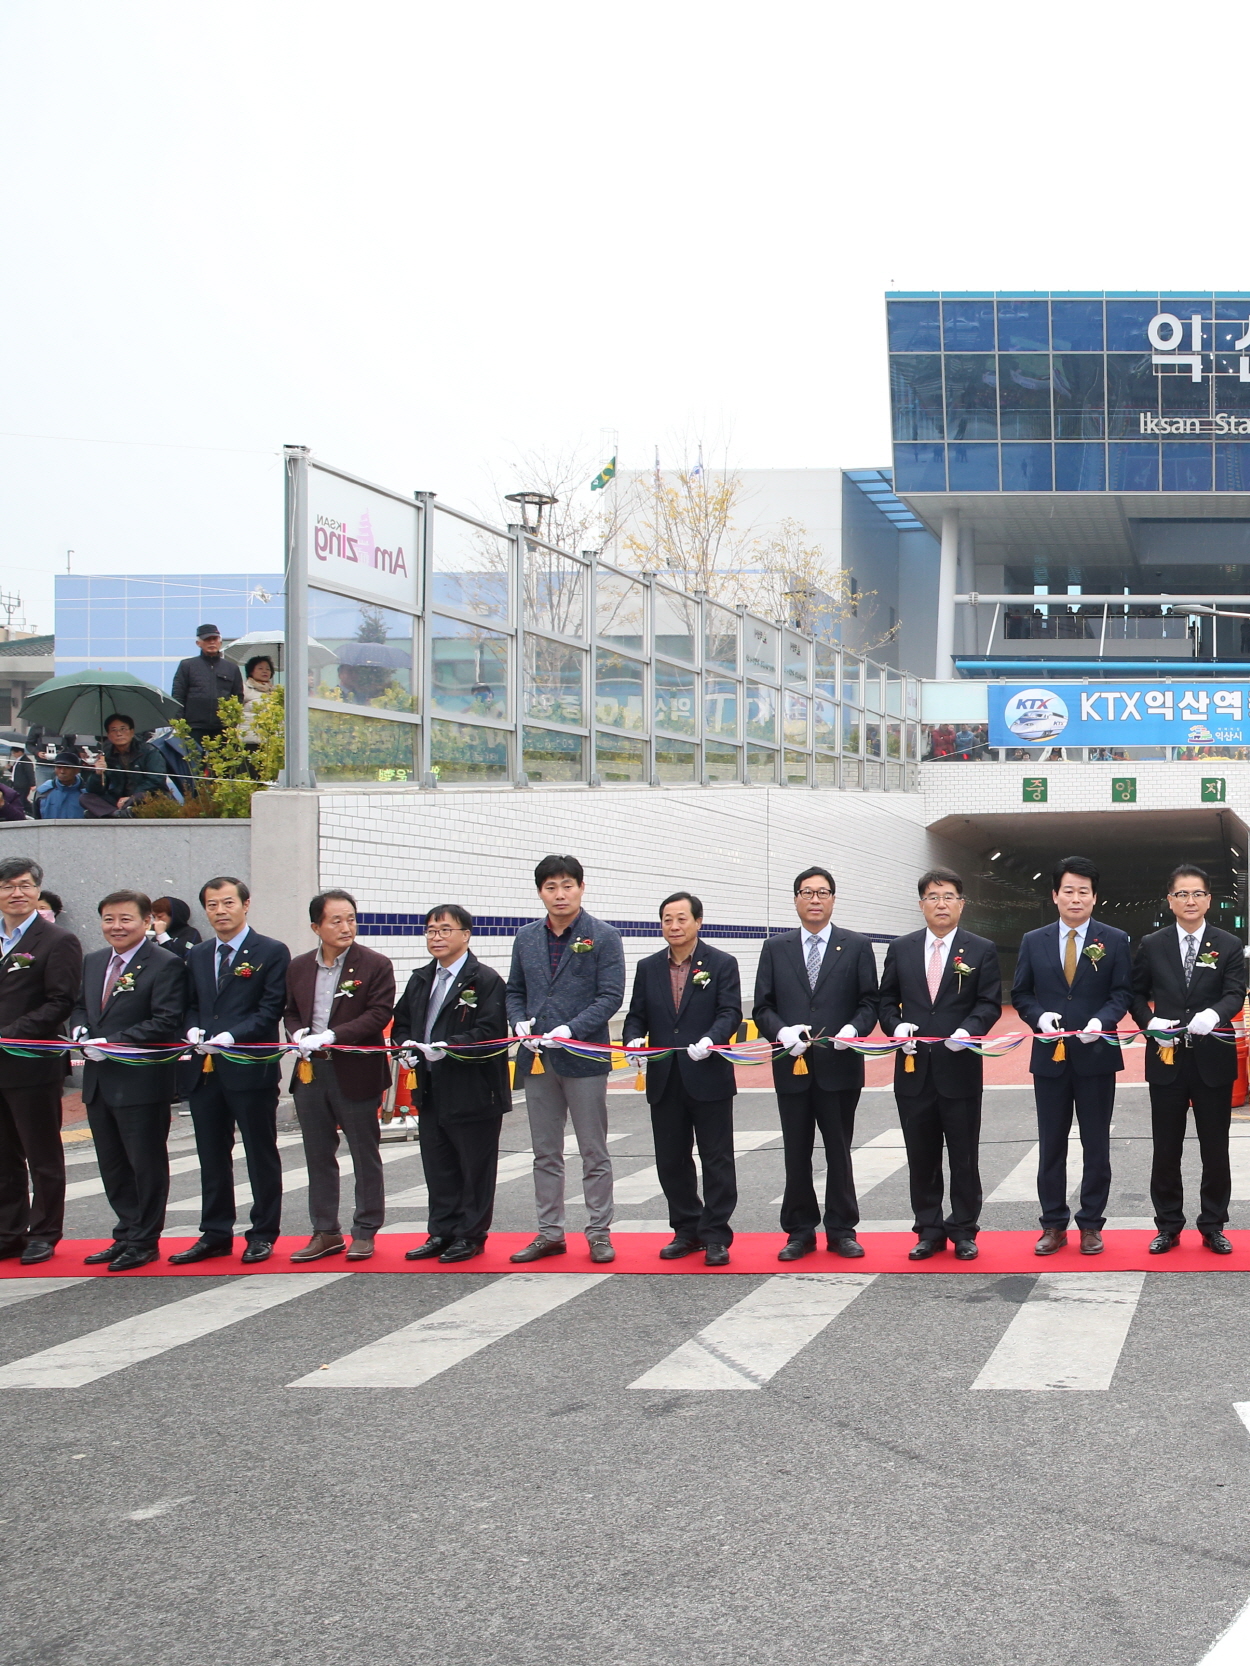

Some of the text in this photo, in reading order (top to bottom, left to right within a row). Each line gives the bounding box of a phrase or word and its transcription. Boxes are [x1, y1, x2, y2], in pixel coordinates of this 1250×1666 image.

[1139, 412, 1200, 435] Iksan
[1016, 697, 1057, 710] KTX
[1214, 731, 1243, 742] 익산시
